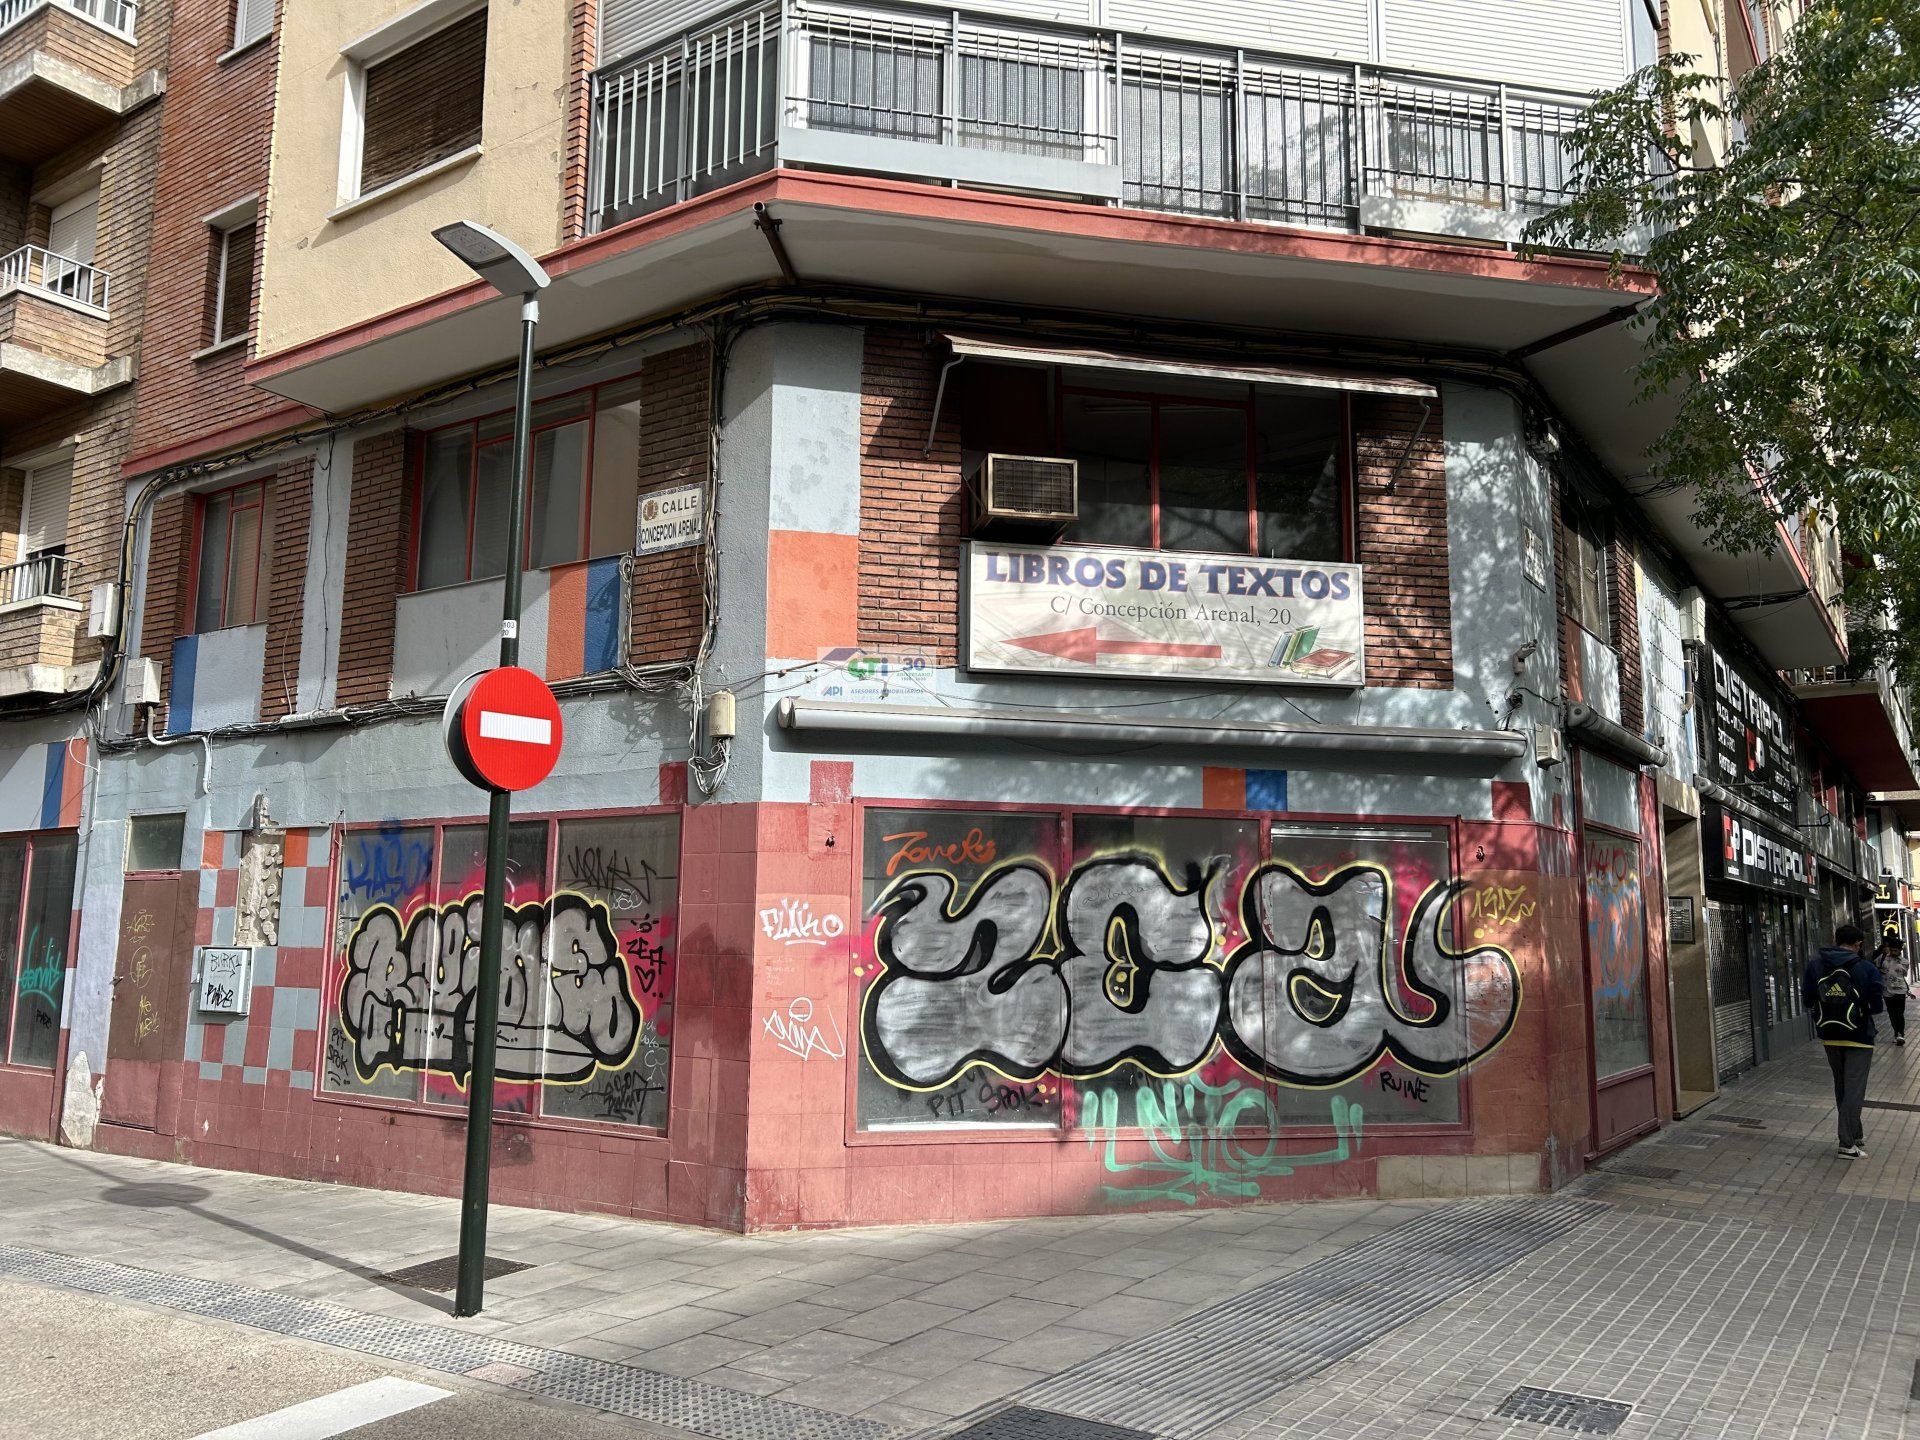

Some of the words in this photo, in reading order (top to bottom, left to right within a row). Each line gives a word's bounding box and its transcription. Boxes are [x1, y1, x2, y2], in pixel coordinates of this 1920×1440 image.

[661, 496, 697, 514] CALLE
[678, 518, 701, 538] ARENAL
[985, 551, 1127, 590] LIBROS
[1138, 560, 1189, 592] DE
[1199, 564, 1351, 601] TEXTOS
[1050, 596, 1073, 616] C/
[1079, 598, 1187, 622] Concepción
[1196, 603, 1261, 627] Arenal,
[1268, 608, 1292, 625] 20
[1713, 649, 1790, 755] DISTRIPOL
[1742, 828, 1808, 884] DISTRIPOL
[1380, 1071, 1431, 1103] RUINE
